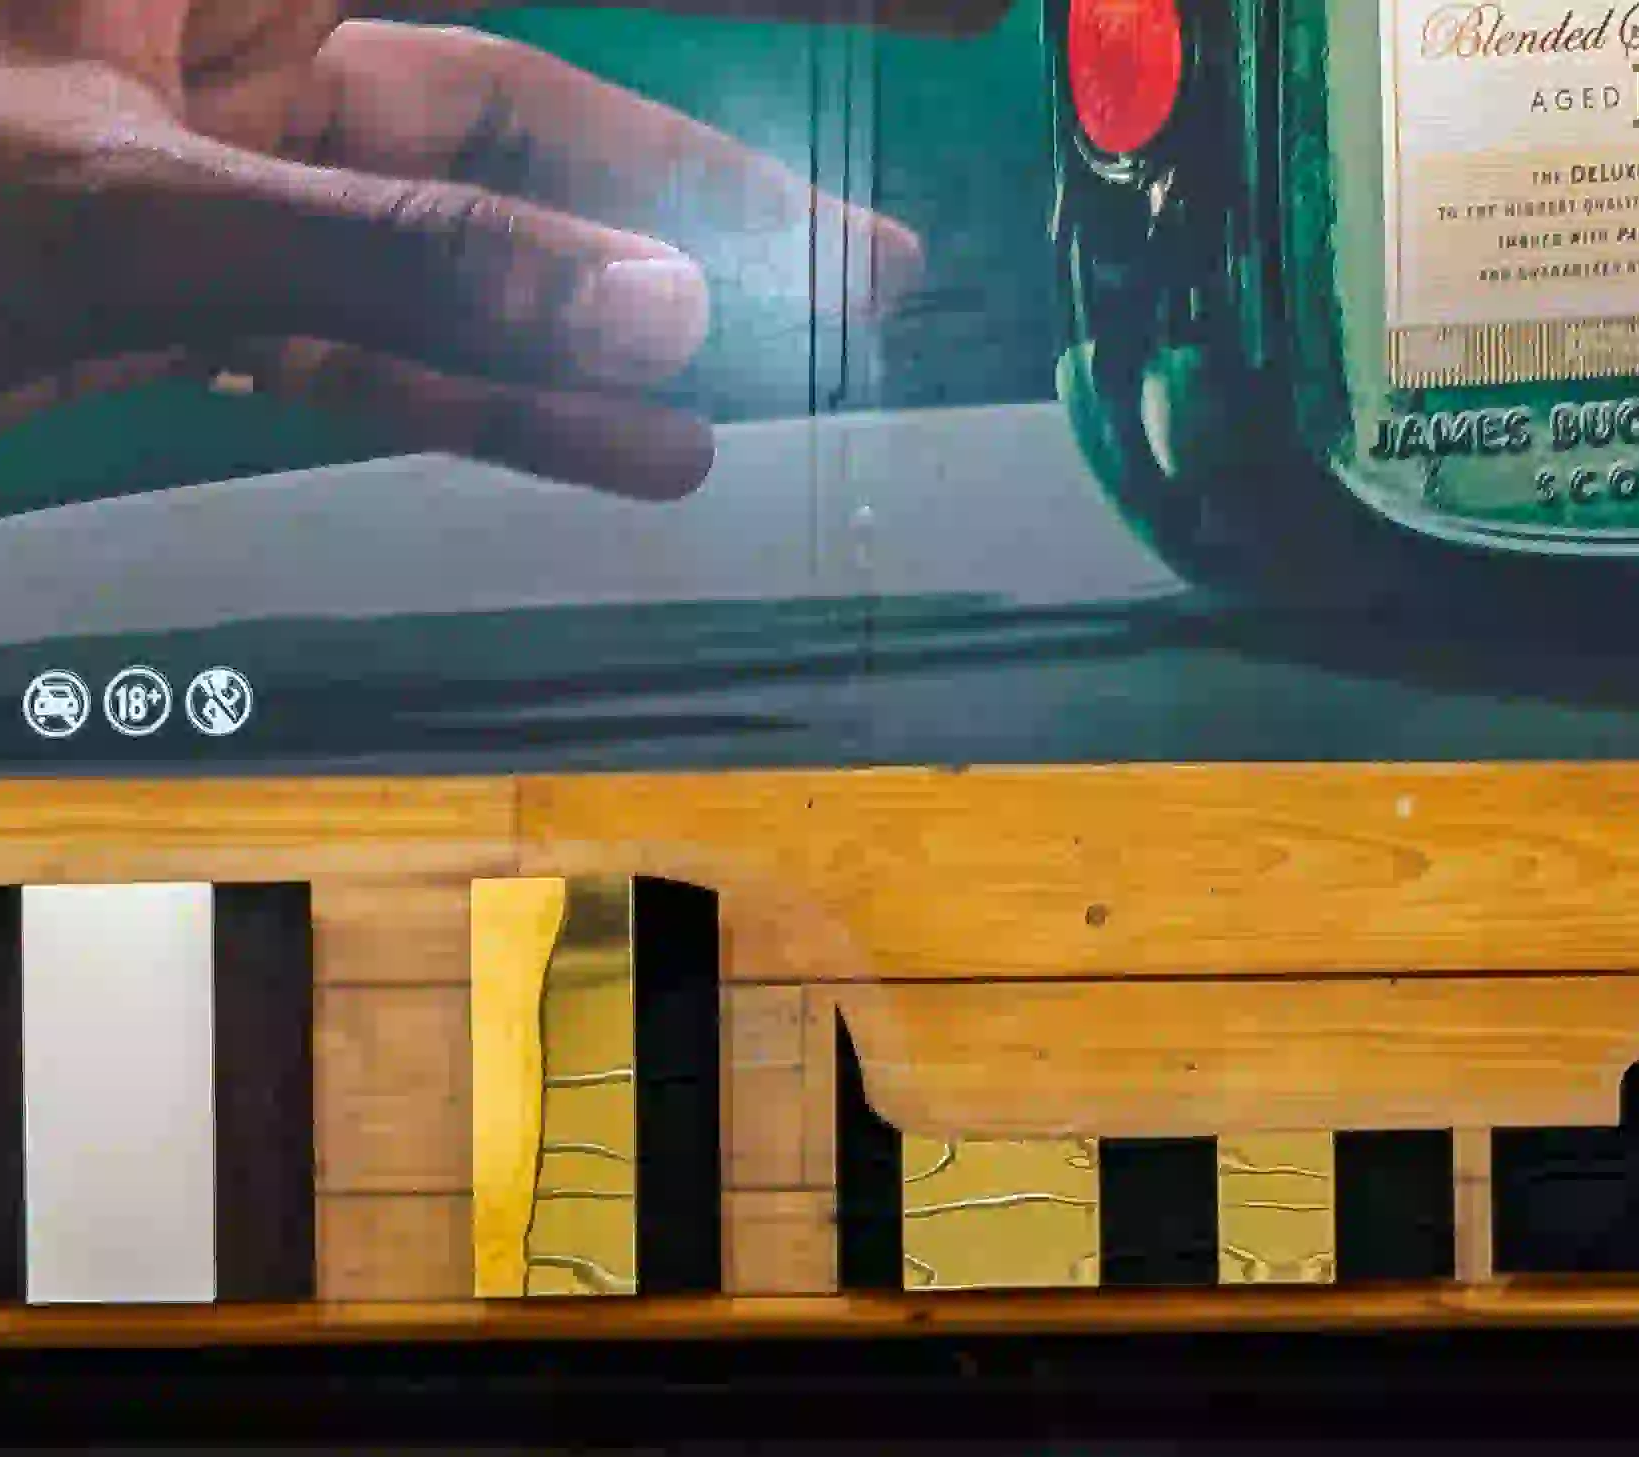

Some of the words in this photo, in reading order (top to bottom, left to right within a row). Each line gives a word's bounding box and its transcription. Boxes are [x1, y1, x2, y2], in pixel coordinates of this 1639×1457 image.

[1421, 3, 1614, 59] Blended
[1531, 85, 1621, 114] AGED
[1369, 403, 1531, 458] JAMES
[112, 686, 162, 724] 18+
